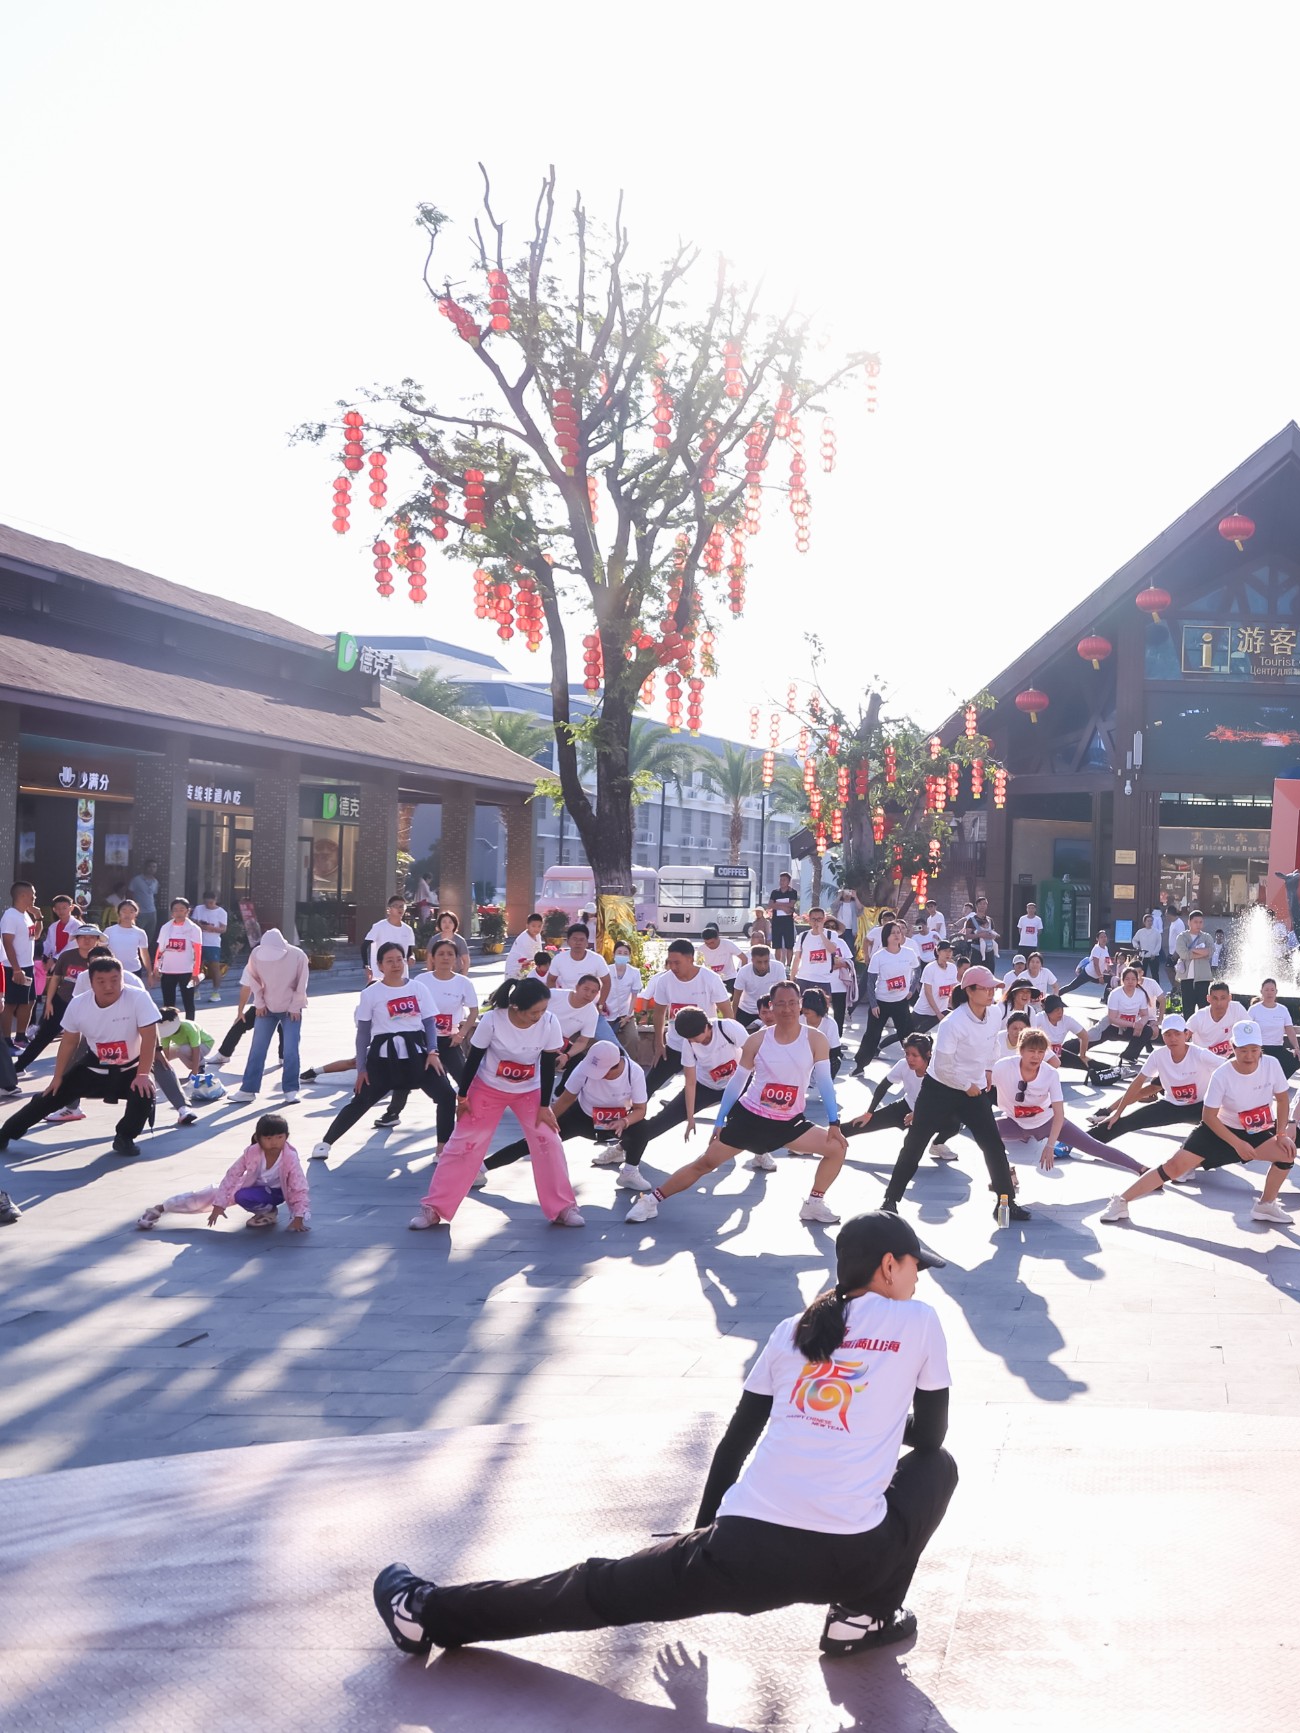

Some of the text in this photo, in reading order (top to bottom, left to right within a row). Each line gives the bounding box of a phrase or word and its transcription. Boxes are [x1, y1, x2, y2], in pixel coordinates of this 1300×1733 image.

[1259, 656, 1295, 667] Tourist
[392, 1001, 415, 1012] 108
[101, 1047, 122, 1058] 094
[502, 1066, 530, 1078] 007
[766, 1088, 793, 1102] 008
[596, 1109, 622, 1120] 024
[1244, 1110, 1267, 1125] 031
